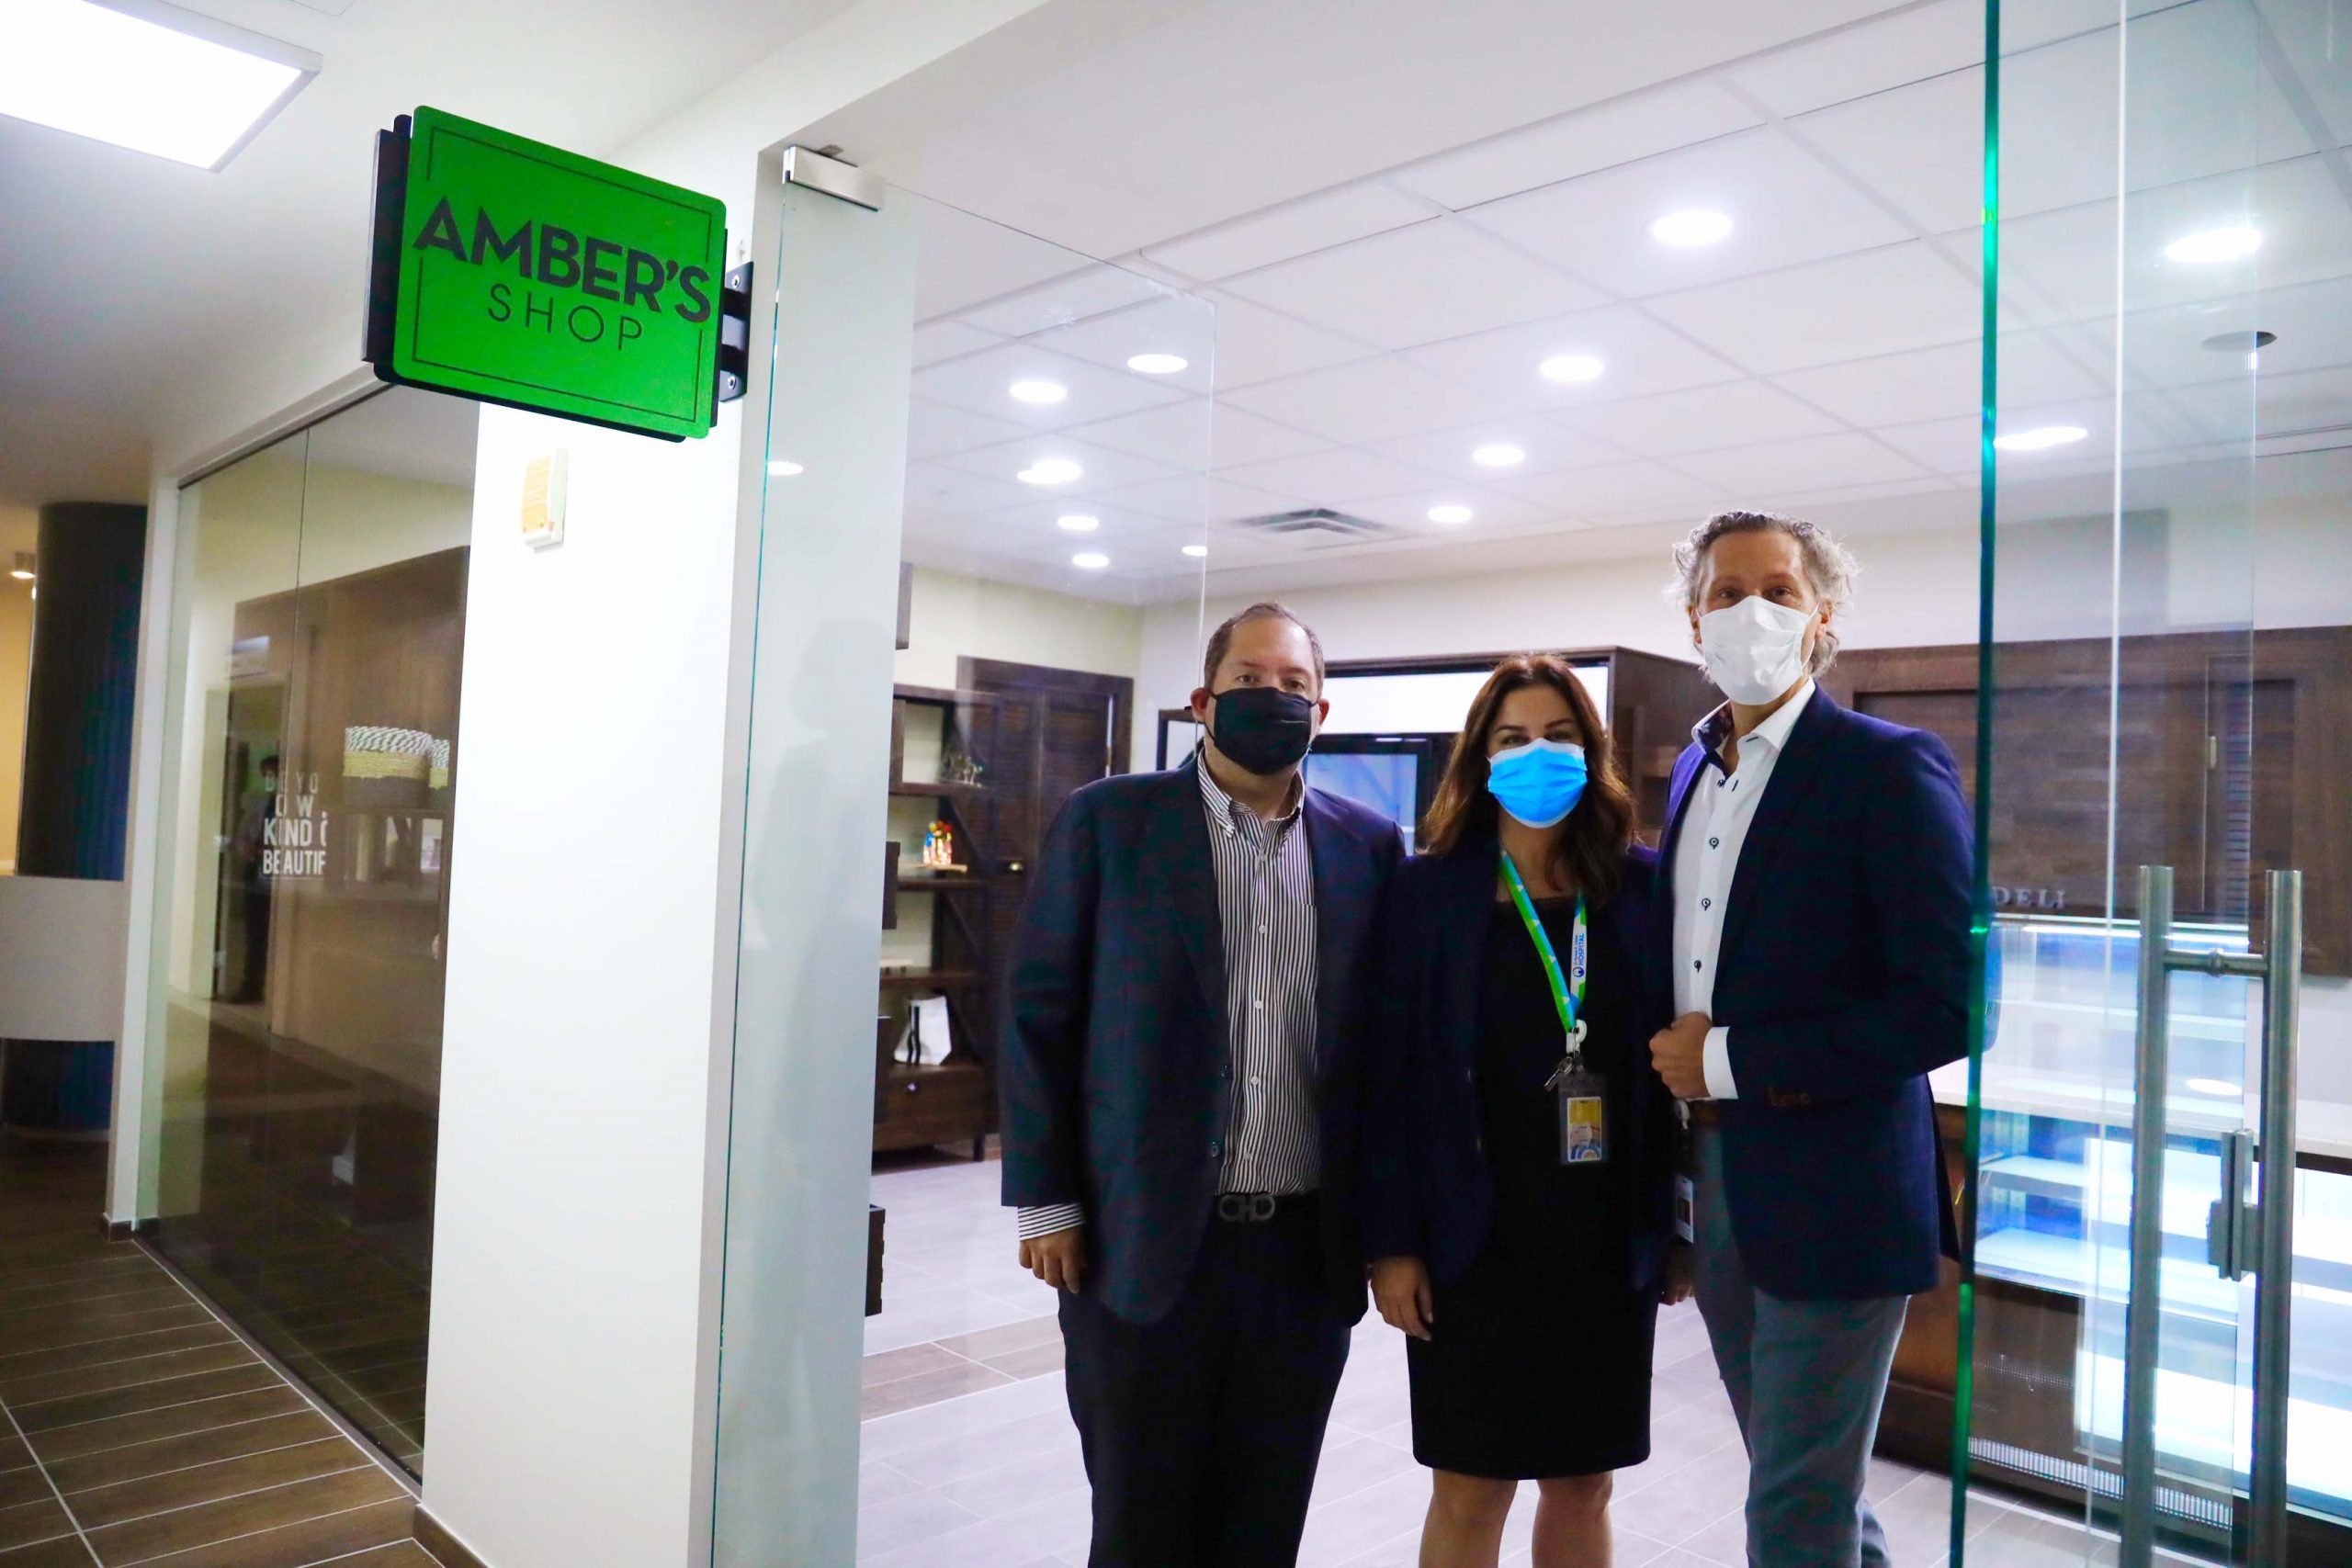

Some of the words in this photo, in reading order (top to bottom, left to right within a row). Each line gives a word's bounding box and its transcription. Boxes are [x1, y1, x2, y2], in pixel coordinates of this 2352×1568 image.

[413, 197, 711, 323] AMBER'S
[488, 284, 642, 350] SHOP
[264, 818, 313, 846] KIND
[1992, 886, 2065, 908] DELI
